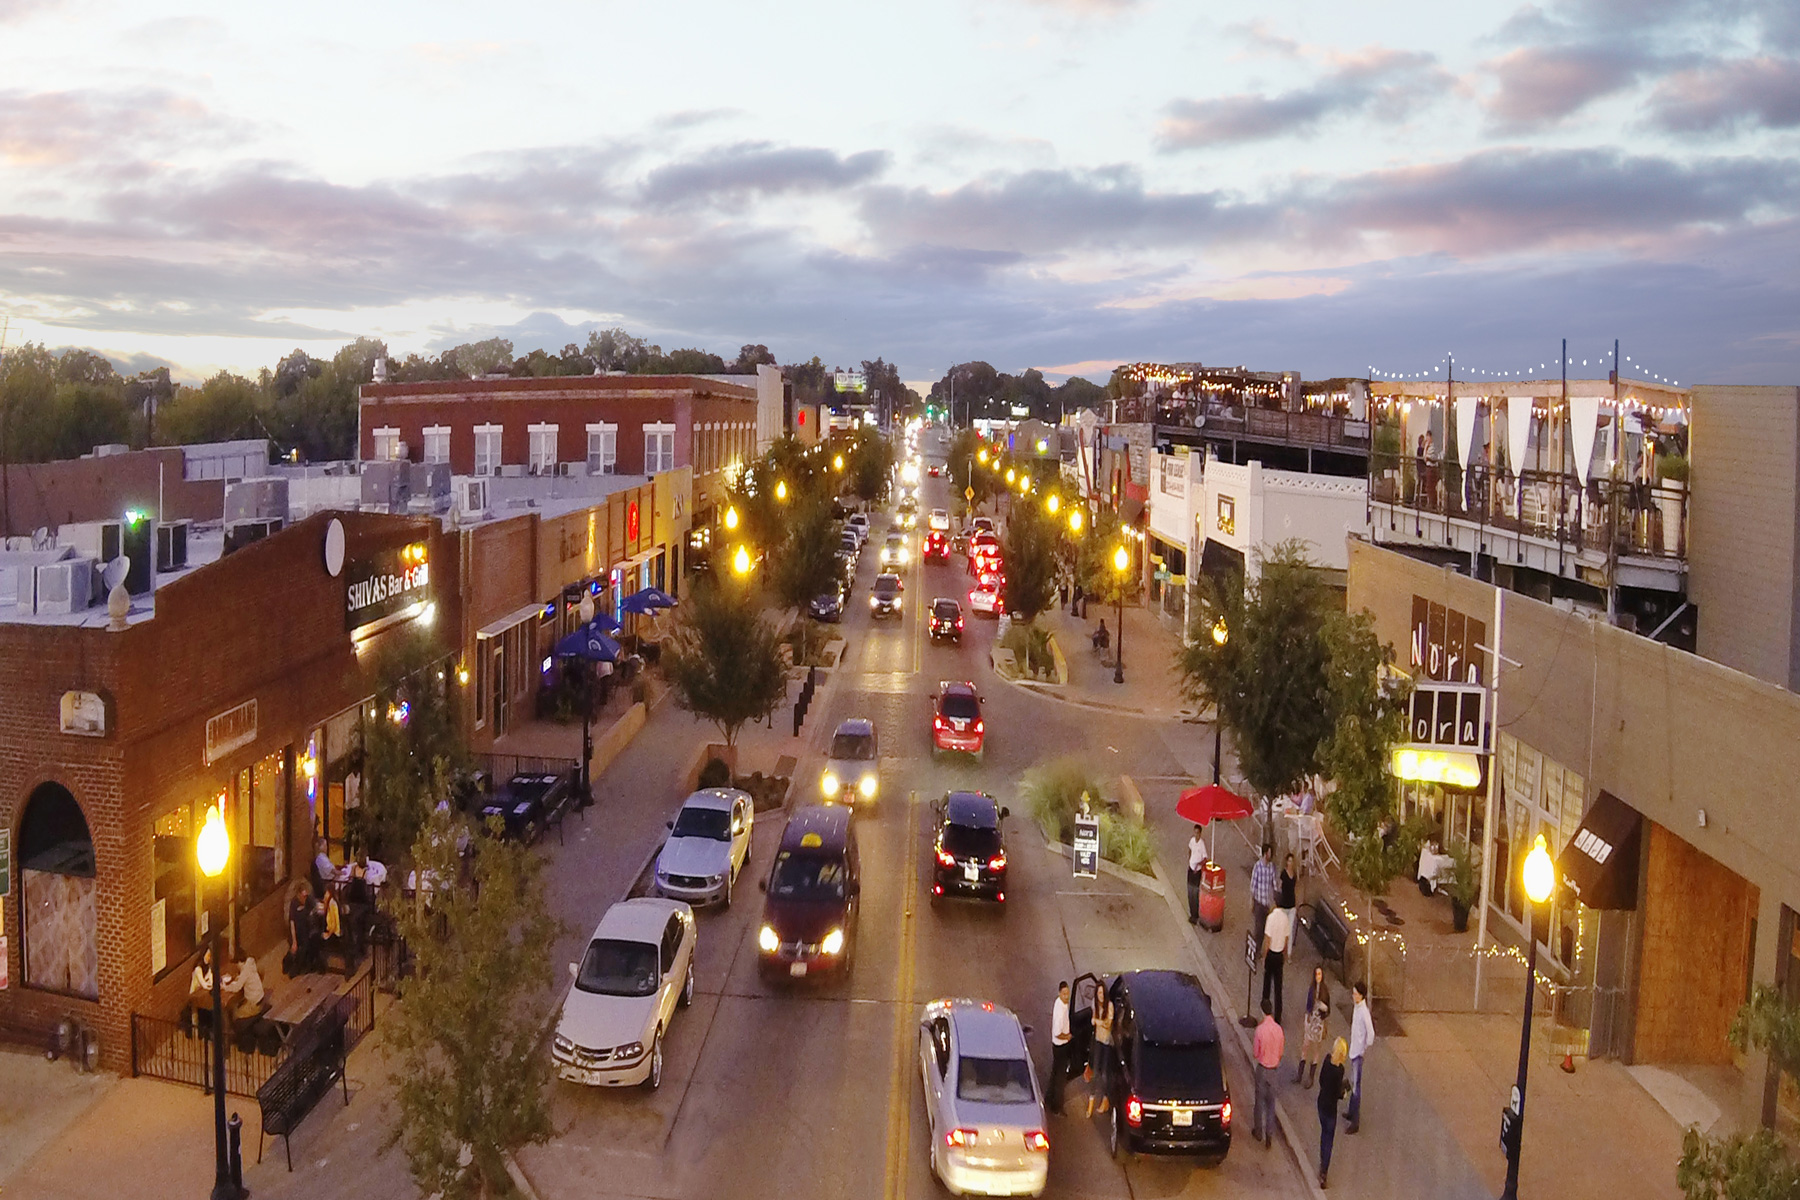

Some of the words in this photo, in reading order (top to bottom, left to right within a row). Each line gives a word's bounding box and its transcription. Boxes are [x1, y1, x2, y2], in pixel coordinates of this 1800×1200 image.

[347, 575, 387, 612] SHIVAS
[388, 574, 404, 597] Bar
[404, 568, 411, 591] &
[412, 563, 429, 589] Grill
[1411, 621, 1477, 684] Nora
[1400, 707, 1475, 743] ora
